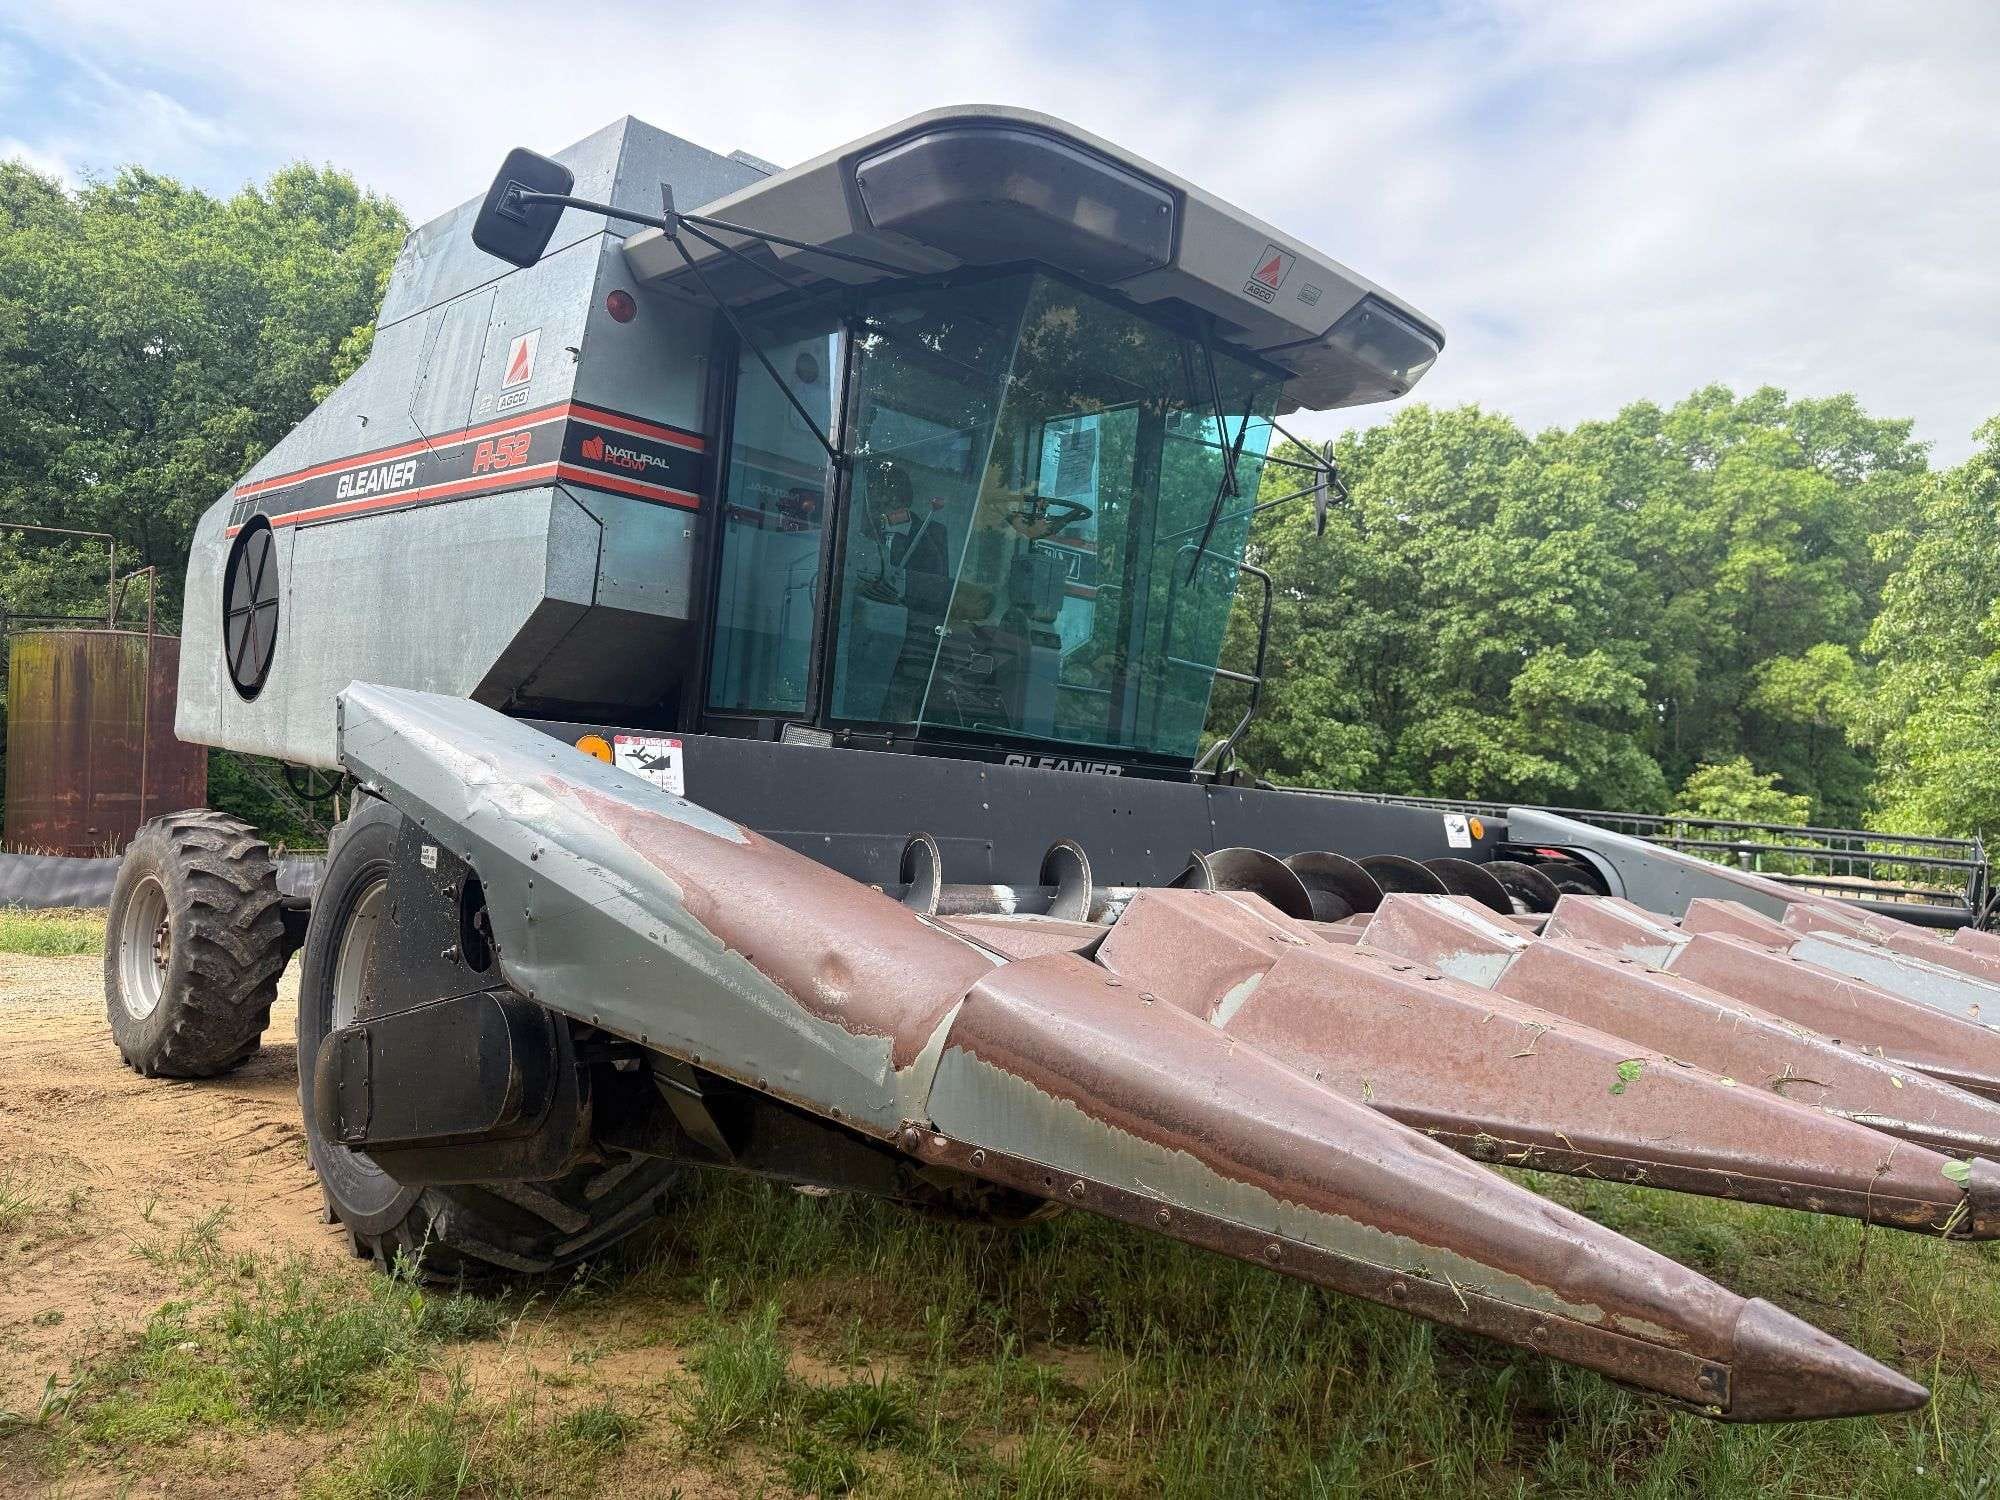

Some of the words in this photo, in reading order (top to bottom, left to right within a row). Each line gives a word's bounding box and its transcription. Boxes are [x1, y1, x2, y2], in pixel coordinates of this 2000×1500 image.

[1247, 285, 1272, 301] AGCO
[500, 392, 526, 408] AGCO
[472, 432, 532, 474] R-52
[604, 454, 647, 472] FLOW
[605, 444, 670, 469] NATURAL
[336, 459, 418, 499] GLEANER
